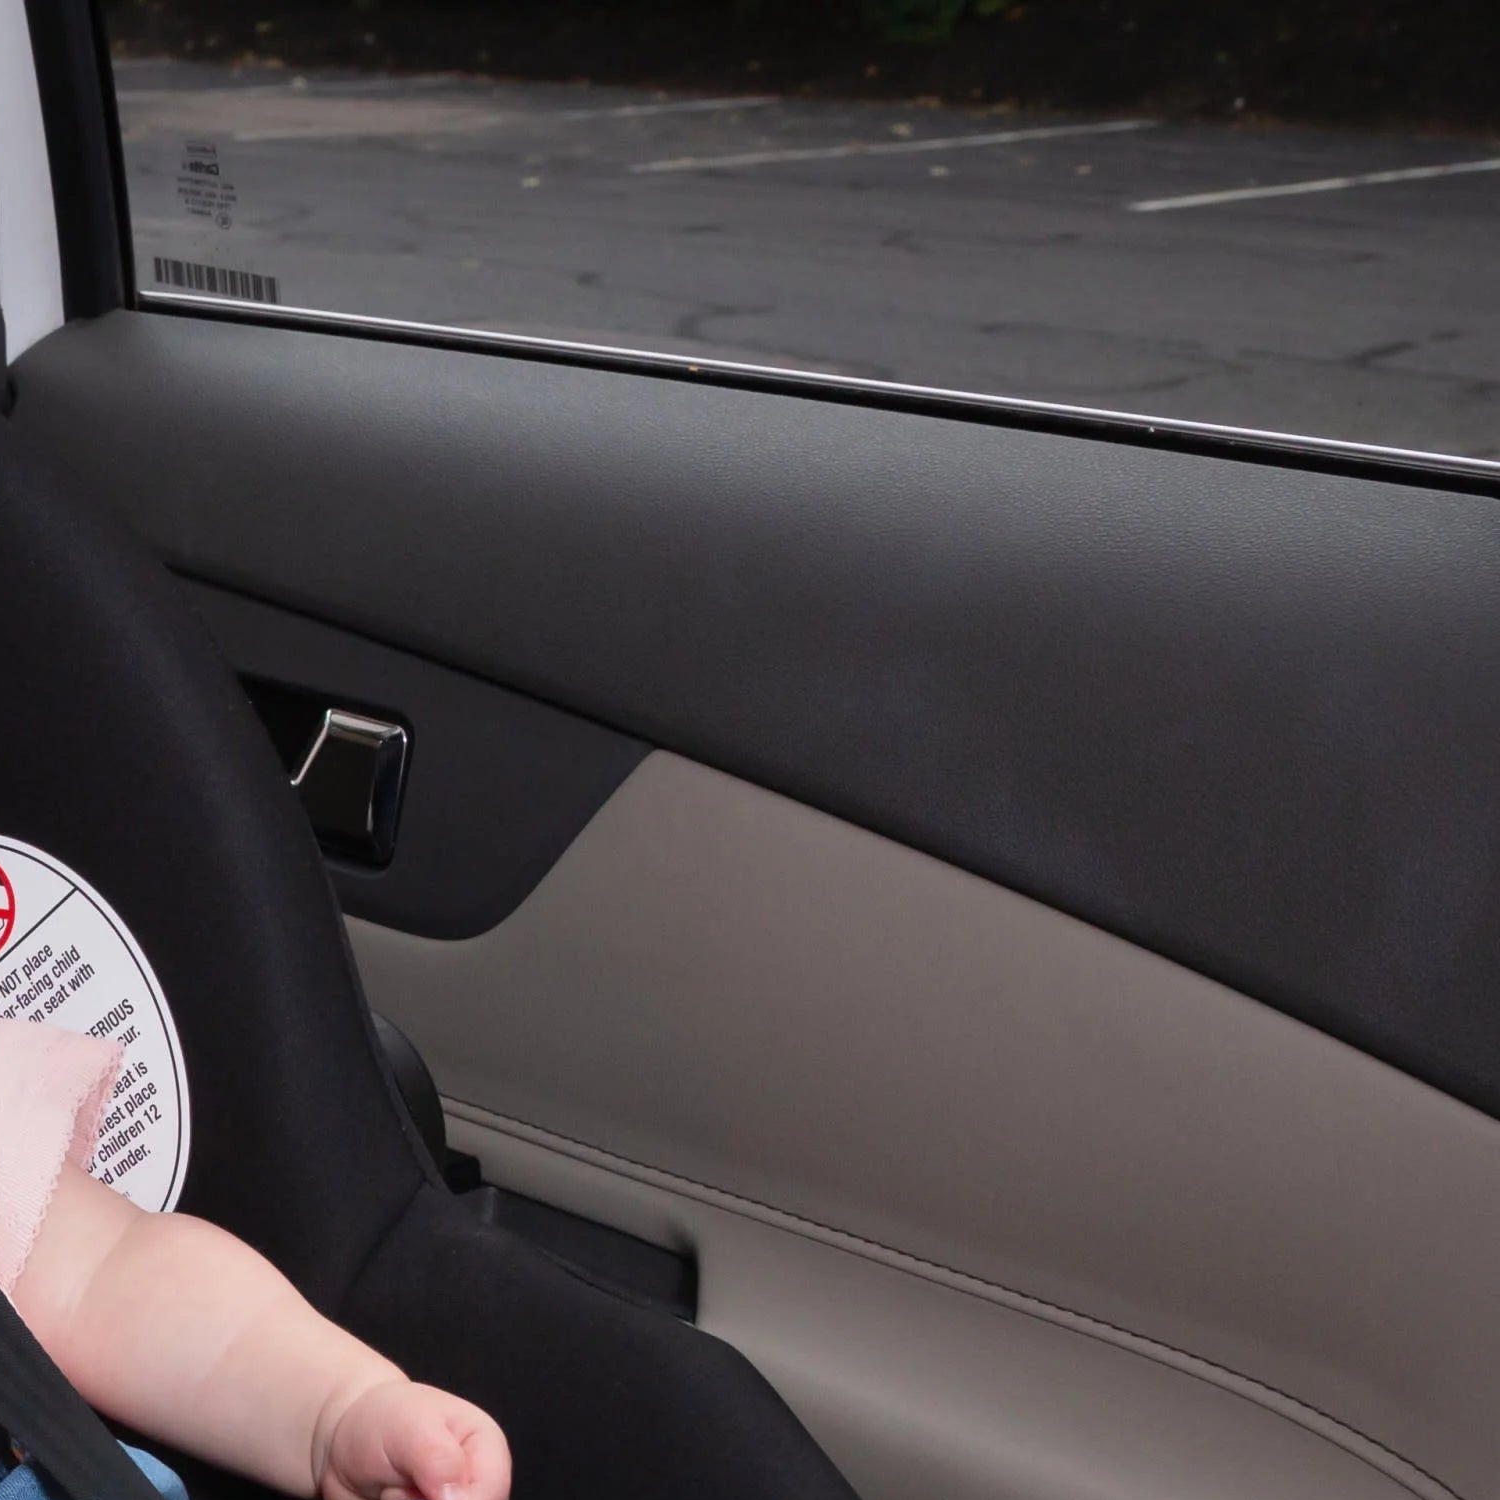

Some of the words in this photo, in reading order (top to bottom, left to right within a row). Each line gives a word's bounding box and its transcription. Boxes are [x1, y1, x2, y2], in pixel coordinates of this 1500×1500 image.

[21, 944, 53, 980] place
[52, 944, 81, 978] child
[44, 984, 70, 1014] seat
[68, 963, 95, 991] with
[84, 998, 134, 1038] ERIOUS
[132, 1062, 148, 1078] is
[124, 1082, 157, 1117] place
[98, 1120, 145, 1162] children
[143, 1104, 162, 1125] 12
[113, 1144, 151, 1177] under.
